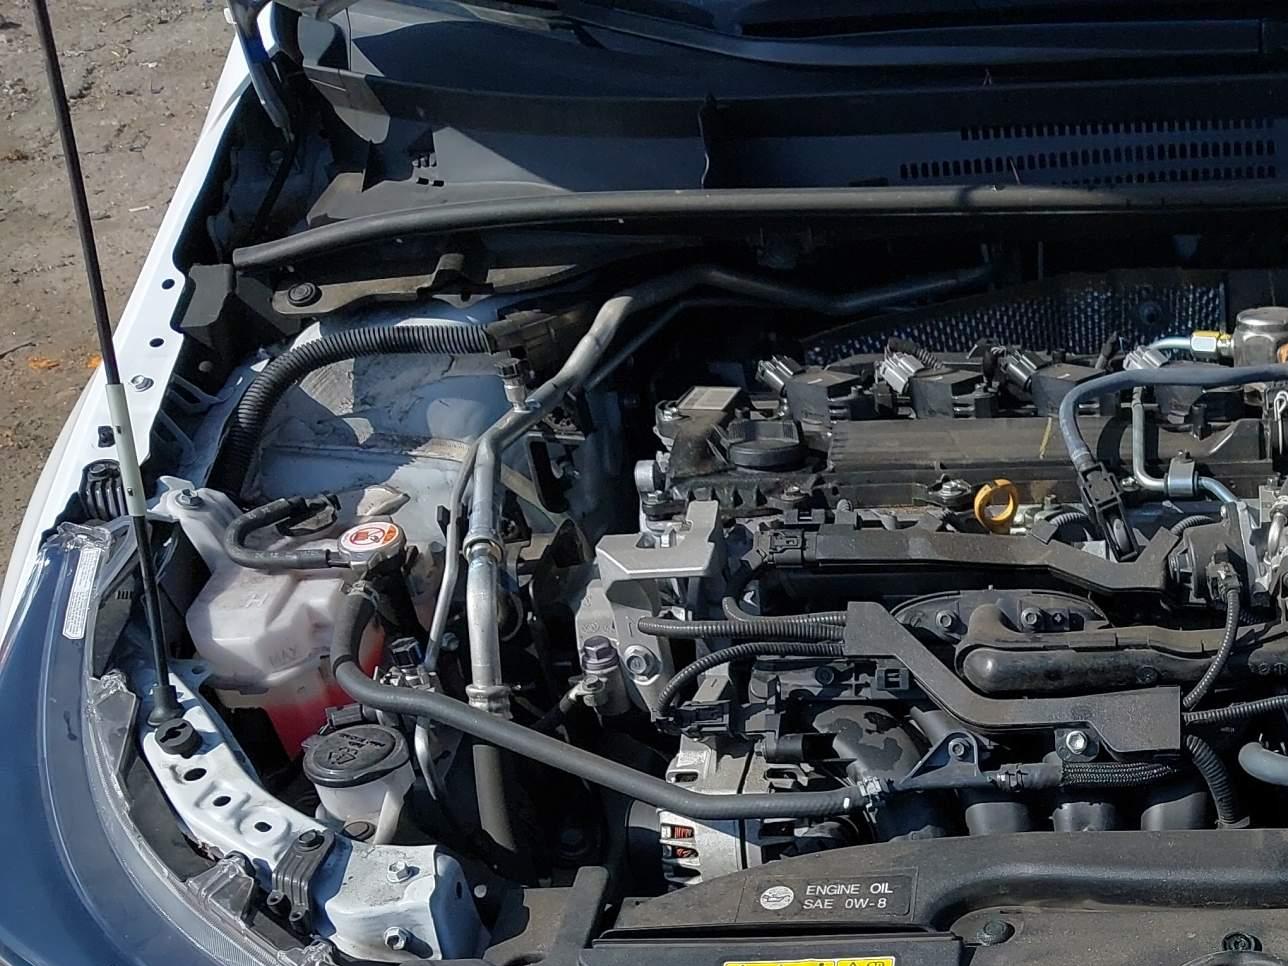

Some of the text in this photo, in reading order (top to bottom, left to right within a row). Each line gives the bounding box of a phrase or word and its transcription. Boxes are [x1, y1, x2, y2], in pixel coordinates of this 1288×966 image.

[806, 883, 893, 895] ENGINE OIL
[803, 898, 887, 909] SAE 0W-8
